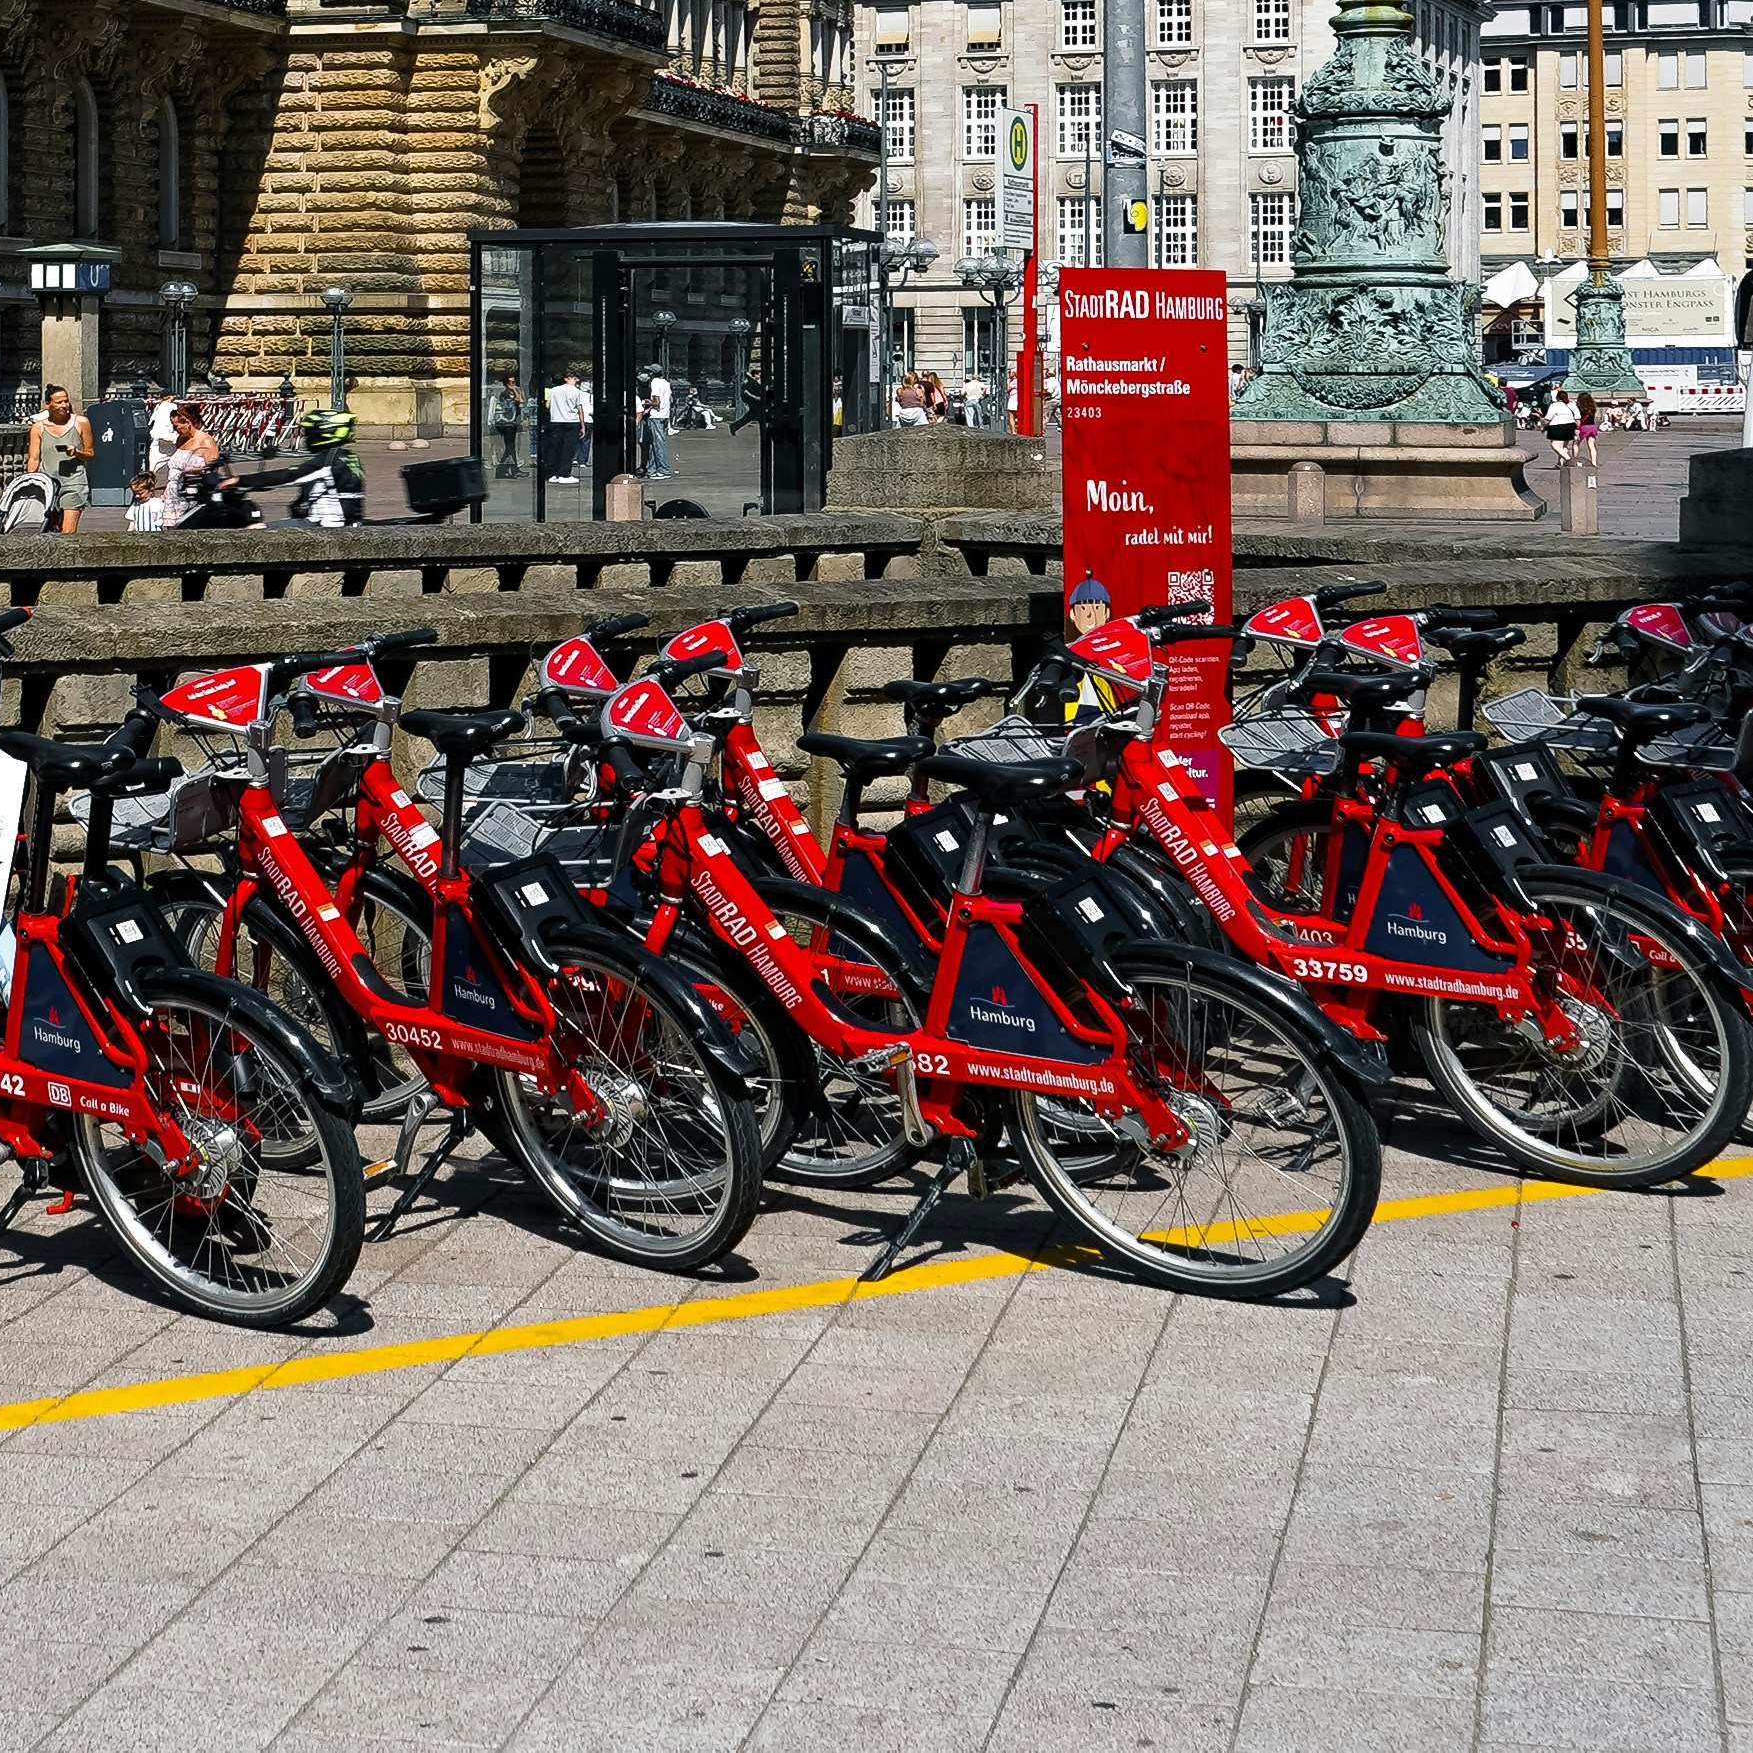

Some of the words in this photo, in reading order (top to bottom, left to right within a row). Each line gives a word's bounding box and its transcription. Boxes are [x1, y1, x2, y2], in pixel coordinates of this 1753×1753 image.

[1066, 356, 1157, 372] Rathausmarkt
[1066, 378, 1191, 398] Mönckebergstraße
[1066, 406, 1102, 418] 23403
[1086, 479, 1155, 514] Moin,
[1125, 526, 1161, 545] radel
[1163, 525, 1184, 545] mit
[1187, 524, 1213, 544] mir!
[1387, 921, 1447, 945] Hamburg
[1293, 958, 1369, 983] 33759
[1385, 972, 1519, 1001] www.stadtradhamburg.de
[454, 984, 496, 1010] Hamburg
[970, 1006, 1036, 1033] Hamburg
[34, 1026, 81, 1053] Hamburg
[385, 1022, 444, 1050] 30452
[451, 1038, 546, 1071] www.stadtradhamburg.de
[967, 1061, 1115, 1095] www.stadtradhamburg.de
[79, 1095, 98, 1110] Call
[100, 1100, 107, 1112] a
[109, 1102, 130, 1117] Bike
